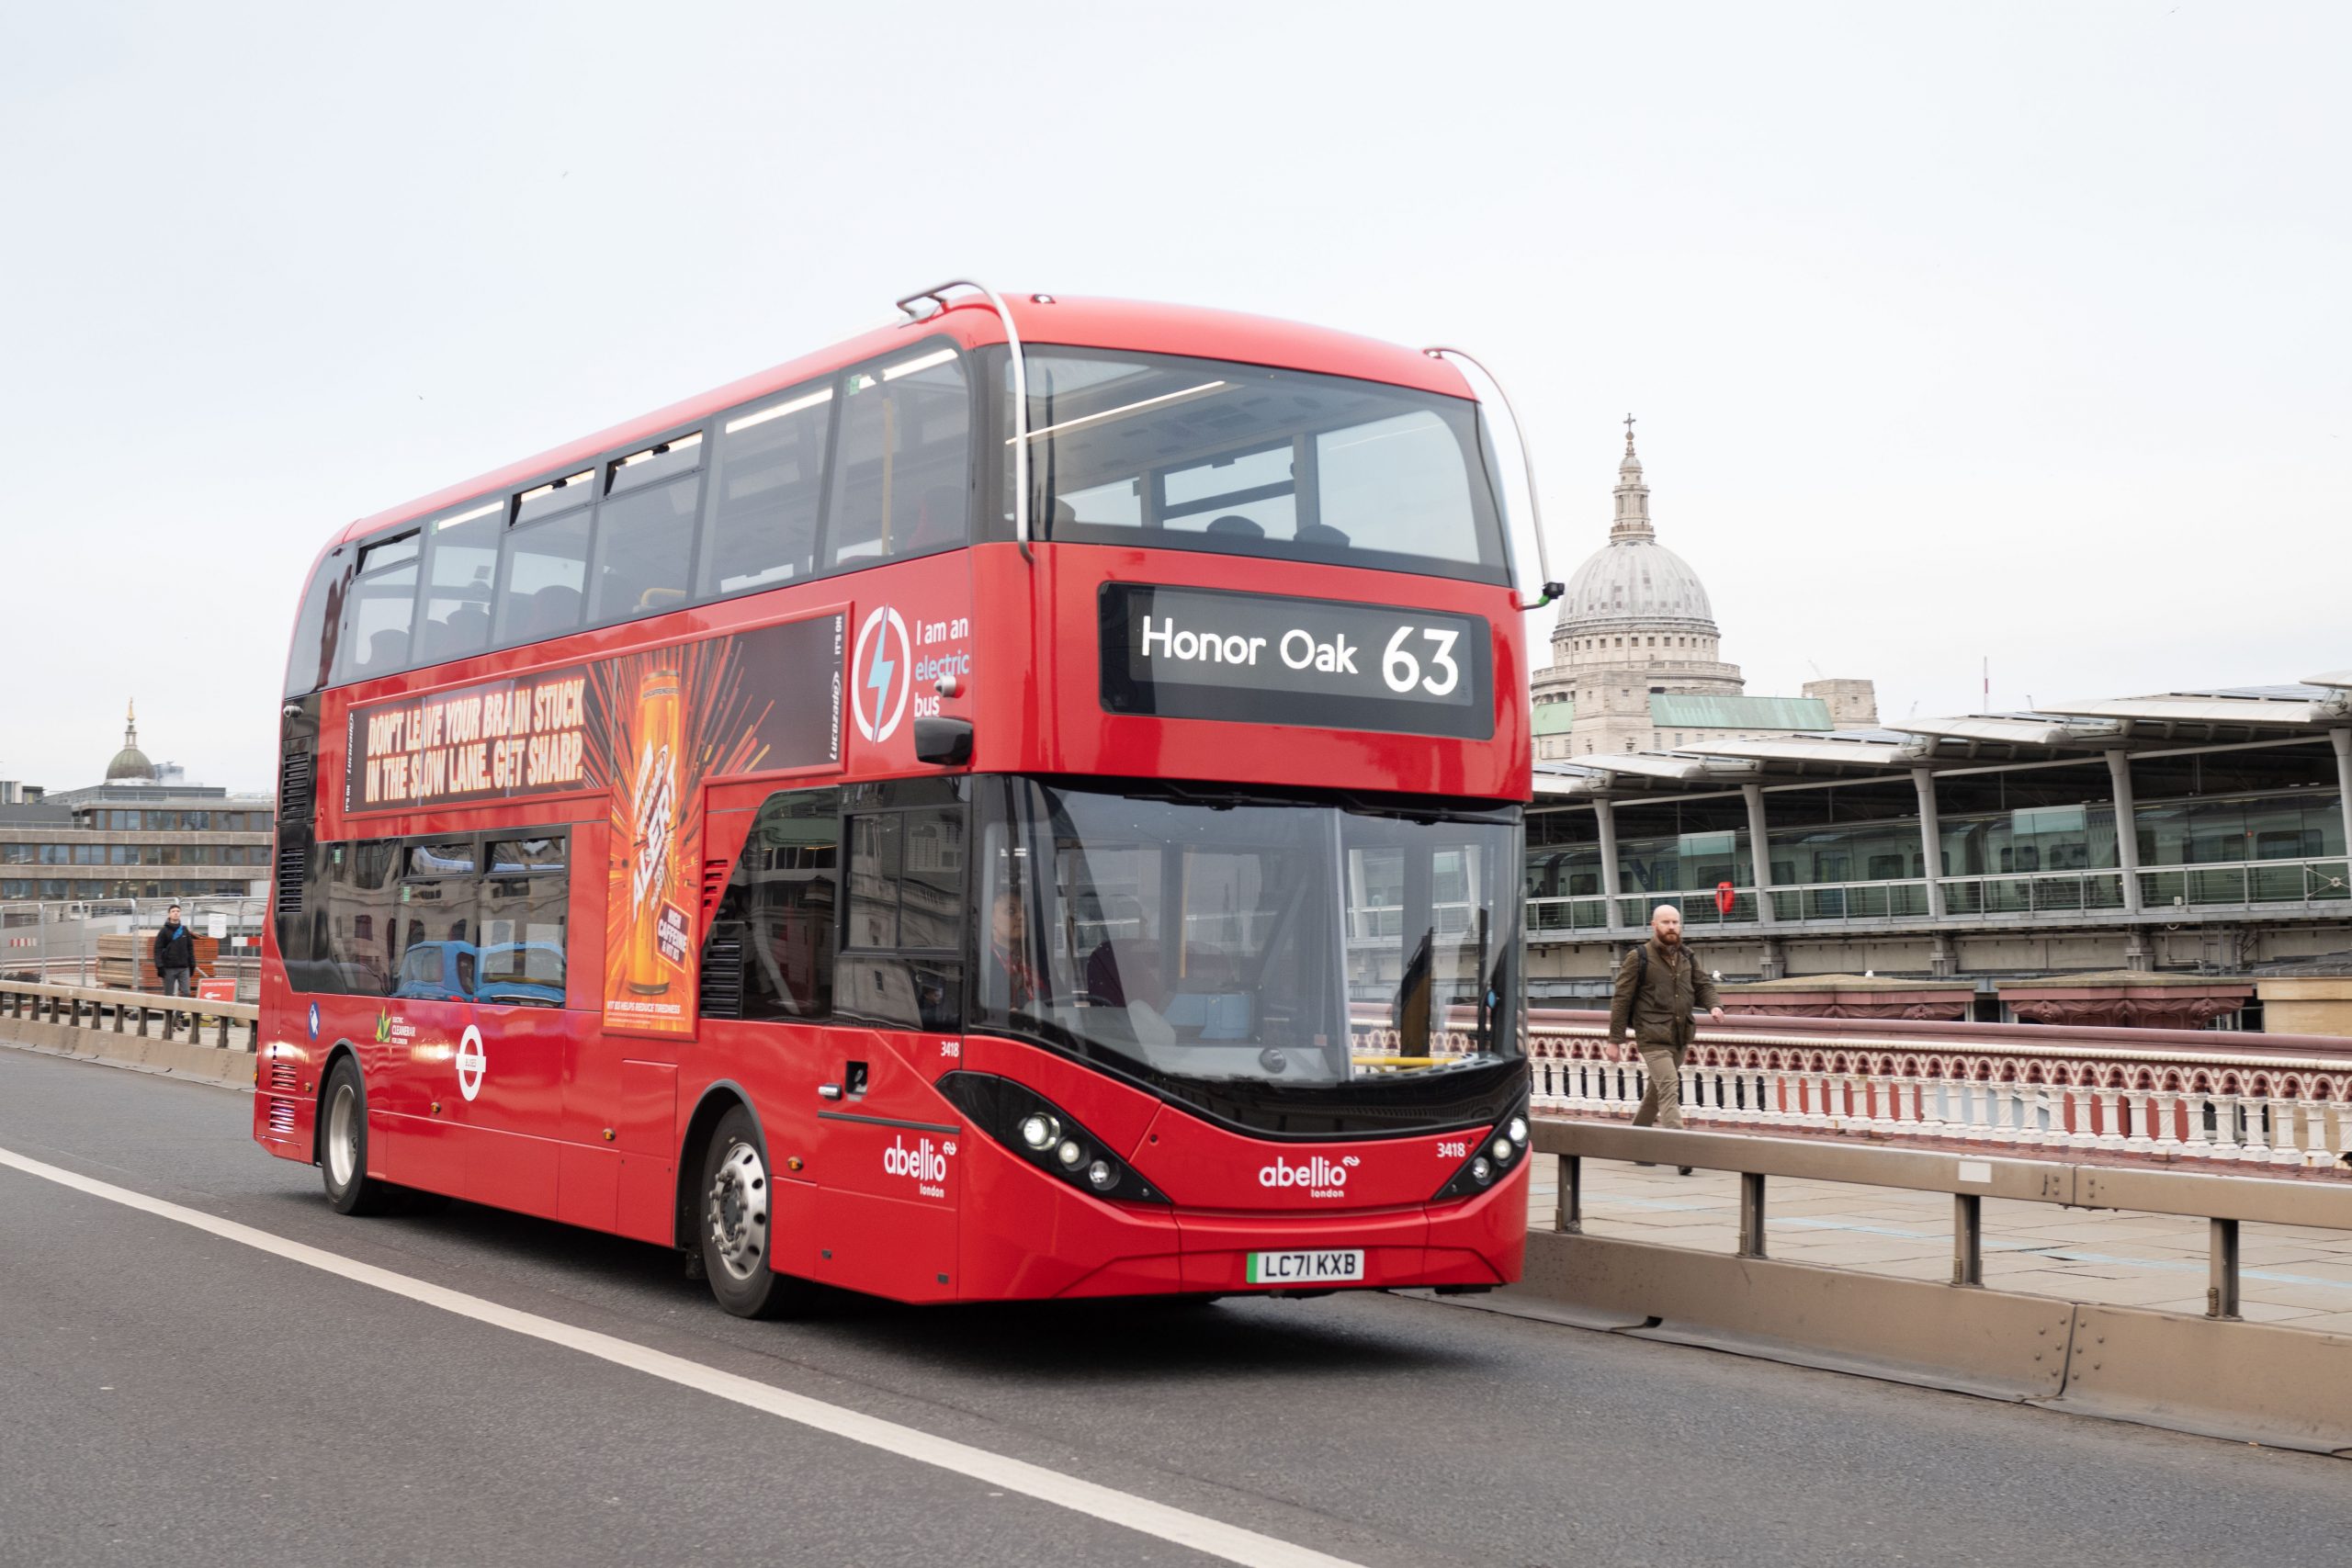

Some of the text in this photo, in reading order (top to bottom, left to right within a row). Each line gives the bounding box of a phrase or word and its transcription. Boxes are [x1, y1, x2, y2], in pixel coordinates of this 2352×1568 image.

[835, 616, 842, 633] ON
[916, 617, 969, 646] I am an
[915, 649, 970, 682] electric
[1142, 615, 1460, 695] Honor Oak 63
[368, 678, 585, 757] DON'T LEAVE YOUR BRAIN STUCK
[914, 692, 941, 717] bus
[366, 731, 584, 803] IN THE SLOW LANE. GET SHARP.
[941, 1041, 959, 1058] 3418
[884, 1134, 946, 1182] abellio
[1437, 1143, 1466, 1157] 3418
[1259, 1156, 1347, 1188] abellio
[920, 1183, 944, 1198] london
[1311, 1189, 1344, 1198] london
[1265, 1253, 1355, 1278] LC71 KXB
